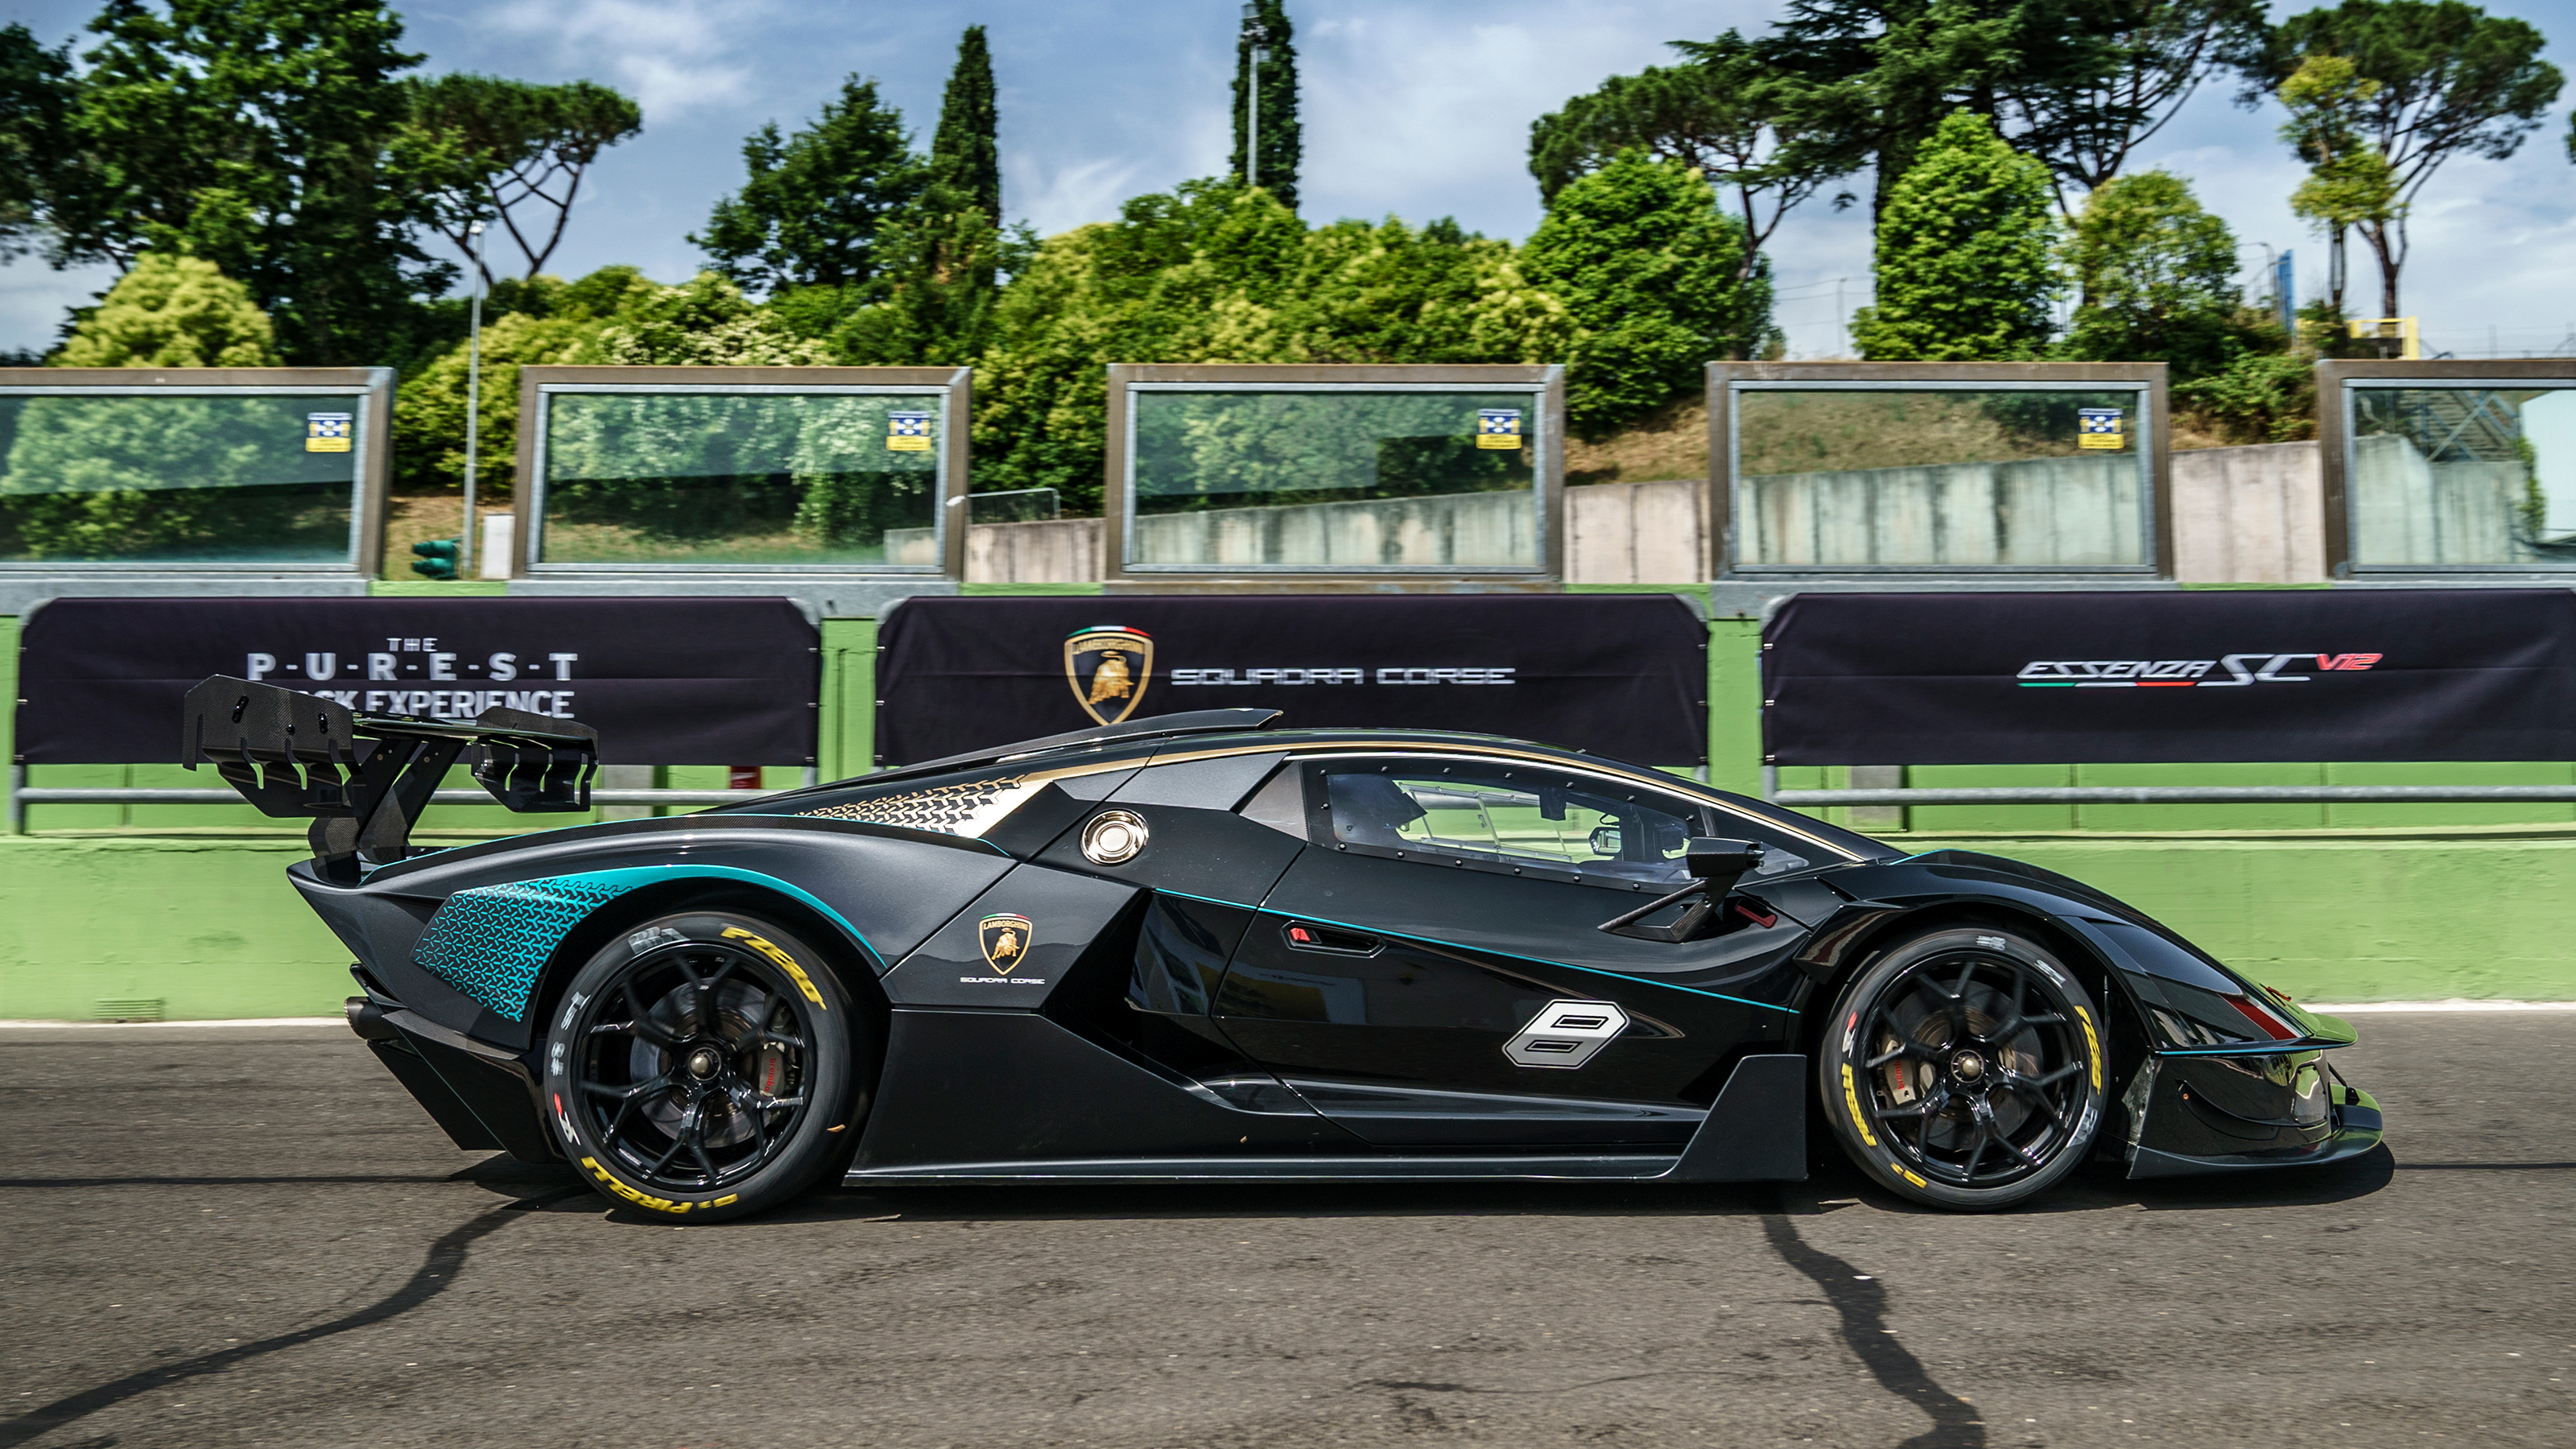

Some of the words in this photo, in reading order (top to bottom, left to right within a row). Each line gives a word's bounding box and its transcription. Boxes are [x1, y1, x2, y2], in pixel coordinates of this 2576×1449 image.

[386, 637, 438, 652] THE
[1170, 667, 1364, 686] SQUADRA
[1377, 667, 1516, 685] CORSE
[2017, 660, 2216, 679] ESSENZA
[365, 690, 575, 718] EXPERIENCE
[983, 920, 1029, 931] LAMBORGHINI
[1502, 998, 1631, 1069] 8
[764, 1058, 776, 1092] brembo
[581, 1156, 693, 1213] PIRELLI
